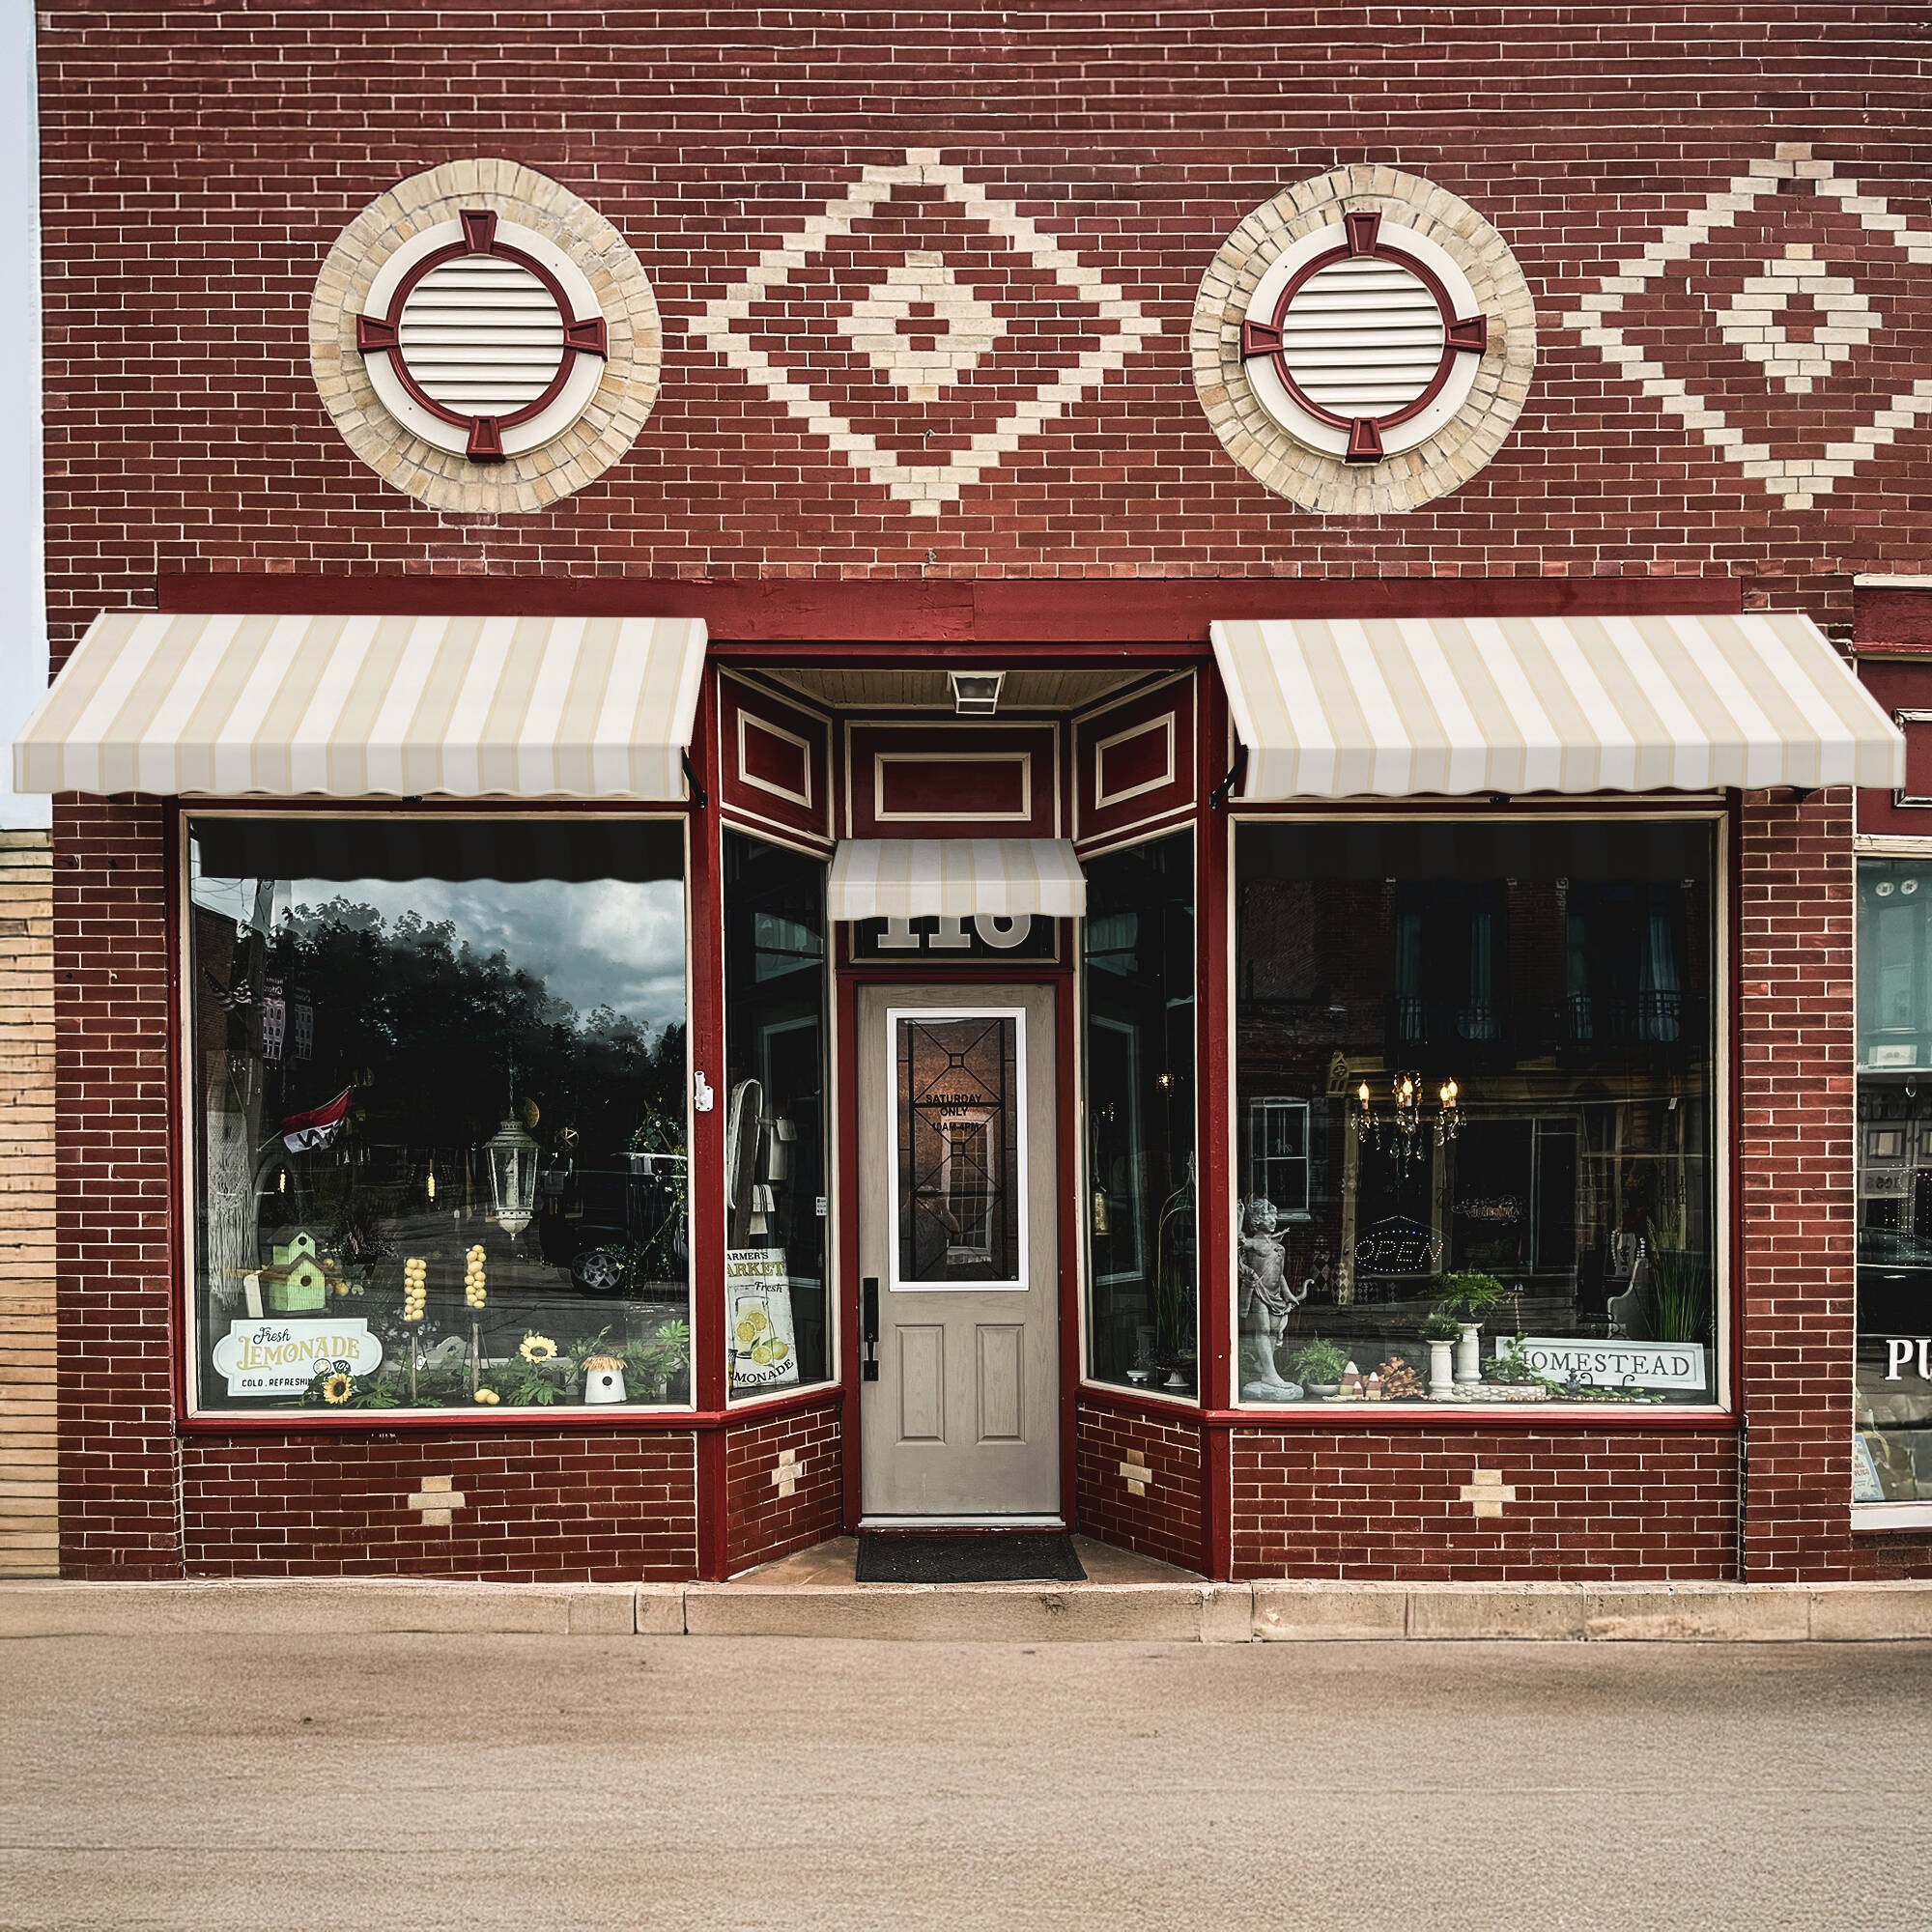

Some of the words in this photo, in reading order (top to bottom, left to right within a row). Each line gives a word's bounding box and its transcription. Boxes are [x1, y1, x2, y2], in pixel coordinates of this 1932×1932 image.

[925, 1094, 982, 1104] SATURDAY
[940, 1107, 969, 1117] ONLY
[932, 1122, 980, 1131] 10AM-4PM
[1354, 1239, 1444, 1264] OPEN
[753, 1281, 782, 1293] Fresh
[252, 1326, 292, 1345] Fresh
[236, 1336, 360, 1371] LEMONADE
